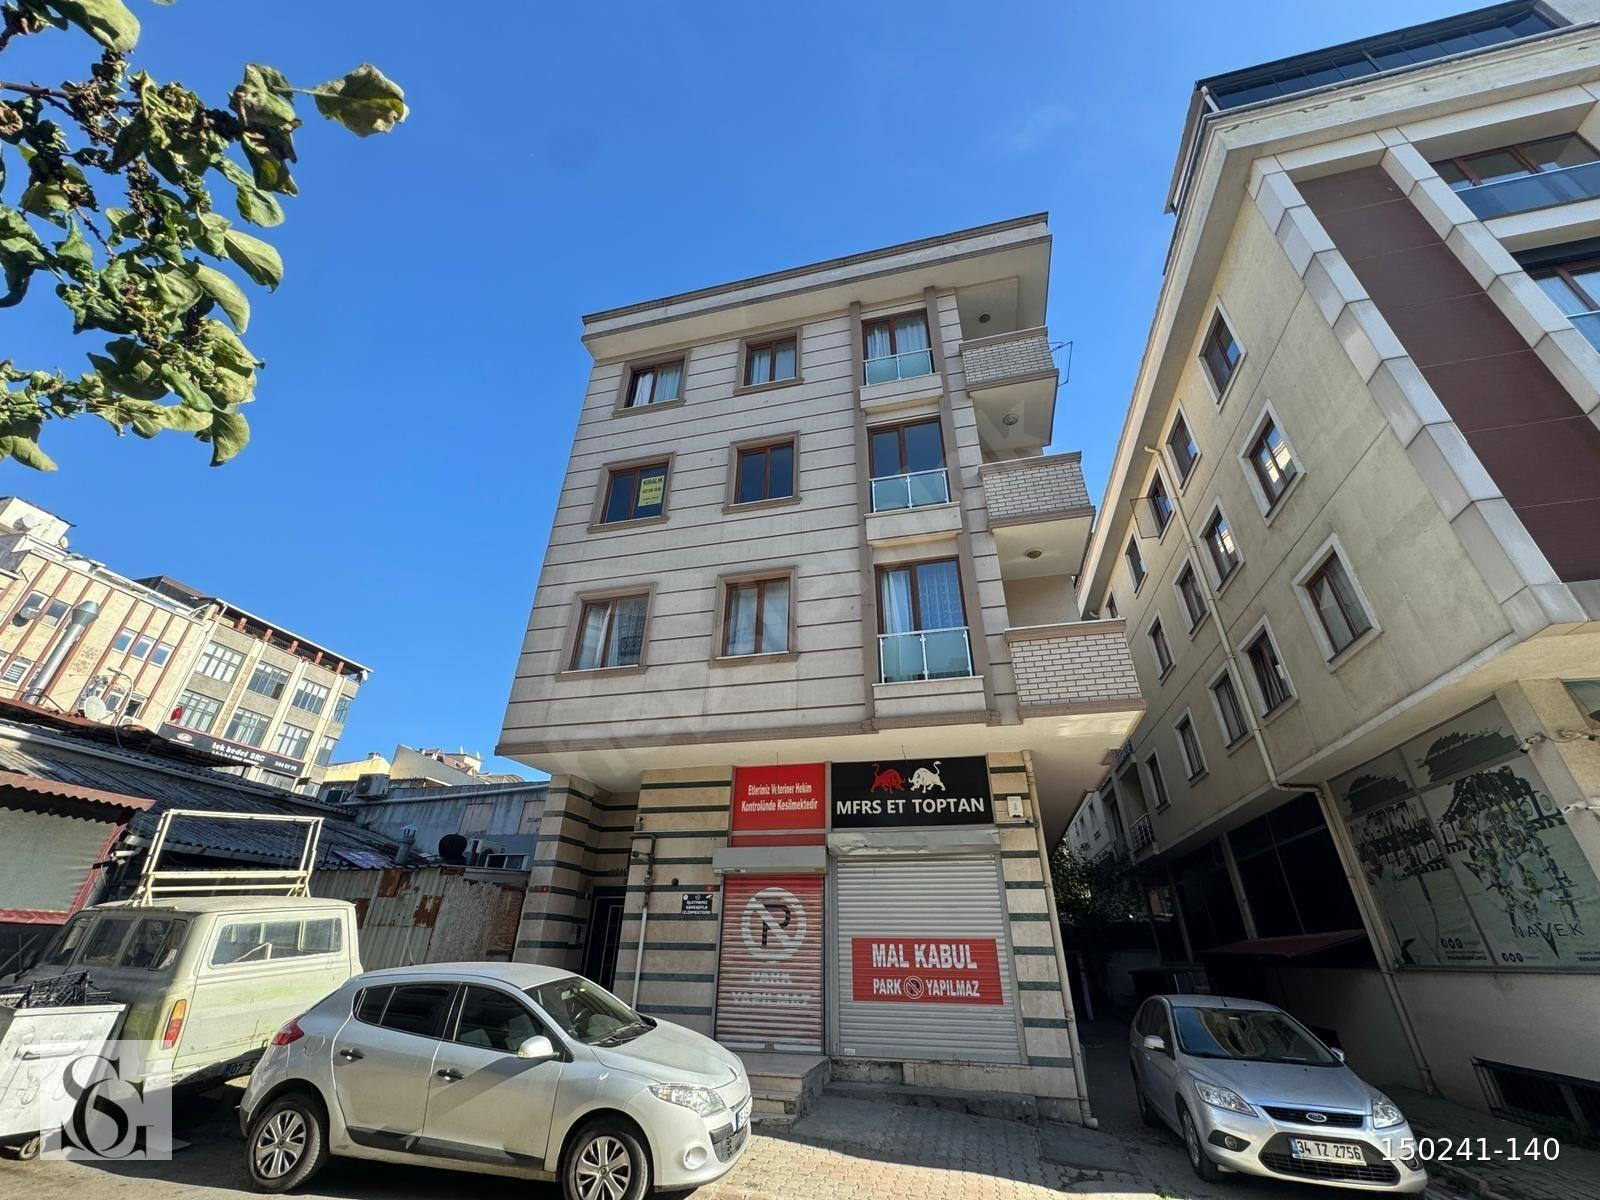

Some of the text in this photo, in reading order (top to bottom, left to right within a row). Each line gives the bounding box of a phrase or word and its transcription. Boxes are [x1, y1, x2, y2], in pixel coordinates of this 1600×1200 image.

[748, 782, 812, 796] Etlerimiz Veteriner Hekim
[741, 797, 818, 812] Kontrolünde Kesilmektedir
[836, 797, 985, 815] MFRS ET TOPTAN
[872, 943, 977, 969] MAL KABUL
[873, 978, 980, 997] PARK YAPILMAZ
[1297, 1141, 1361, 1160] 34 TZ 2756
